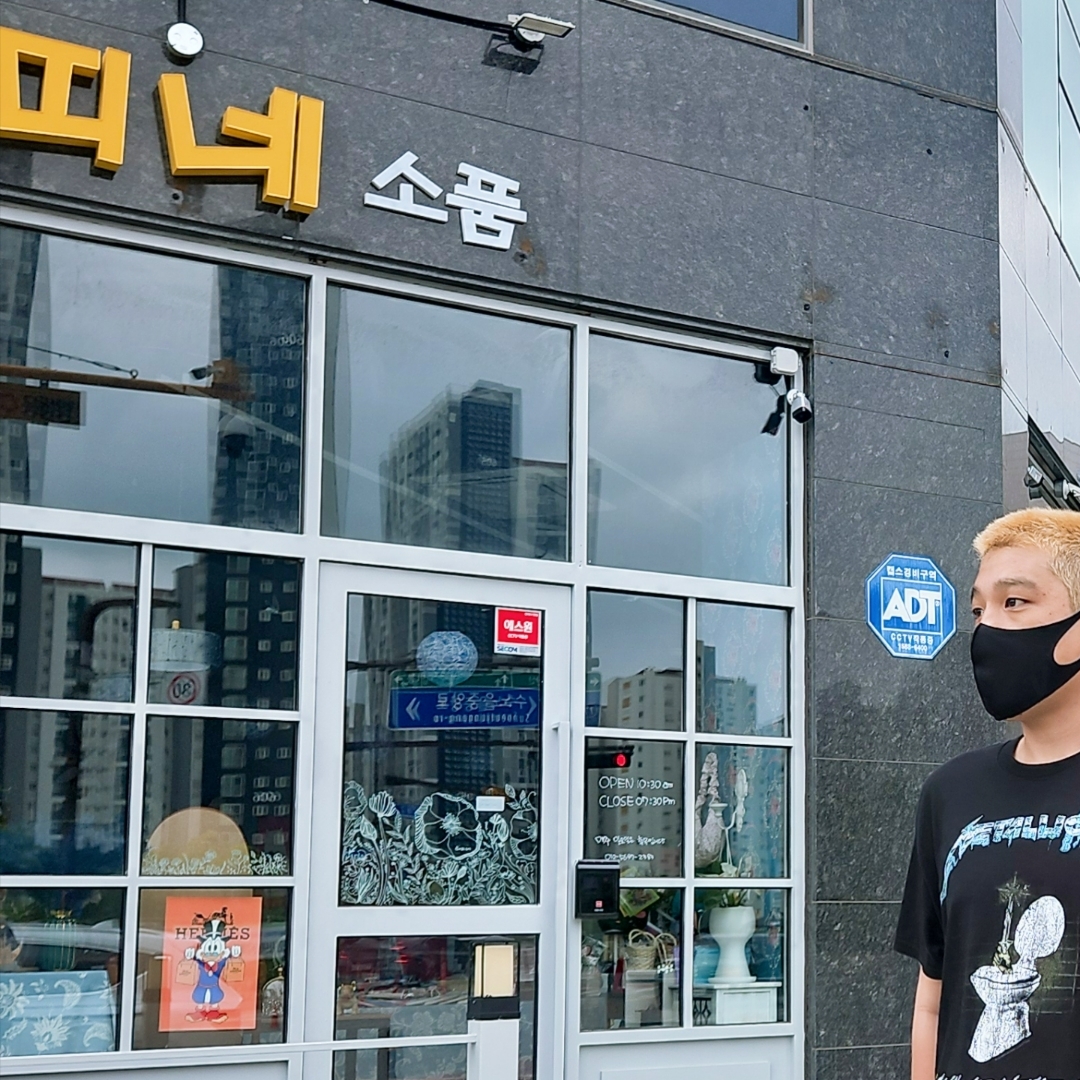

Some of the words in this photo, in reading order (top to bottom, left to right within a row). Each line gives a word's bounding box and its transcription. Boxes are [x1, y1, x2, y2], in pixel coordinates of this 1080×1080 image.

[363, 150, 527, 250] 소품
[883, 587, 941, 625] ADT
[503, 619, 534, 634] 에스원
[598, 775, 634, 789] OPEN
[598, 794, 634, 808] CLOSE
[175, 926, 251, 940] HEÈS
